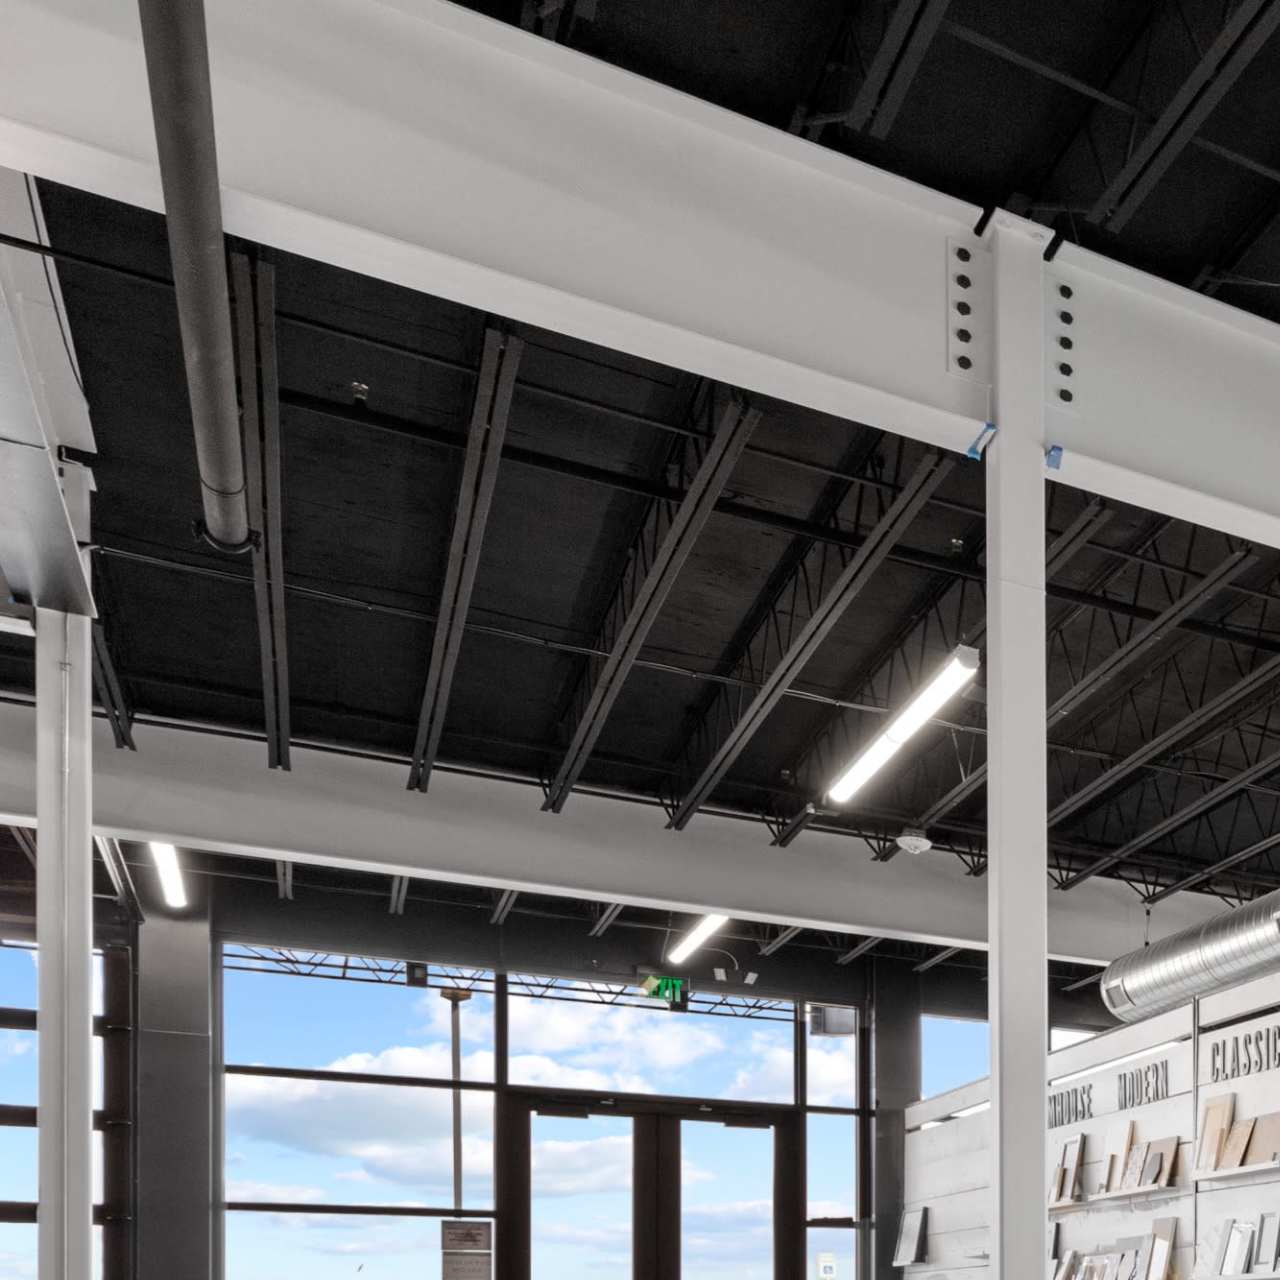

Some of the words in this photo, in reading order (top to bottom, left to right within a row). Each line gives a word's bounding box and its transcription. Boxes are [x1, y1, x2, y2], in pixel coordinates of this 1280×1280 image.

[648, 978, 684, 1003] XIT
[1047, 1082, 1094, 1130] MHOUSE
[1117, 1059, 1169, 1111] MODERN
